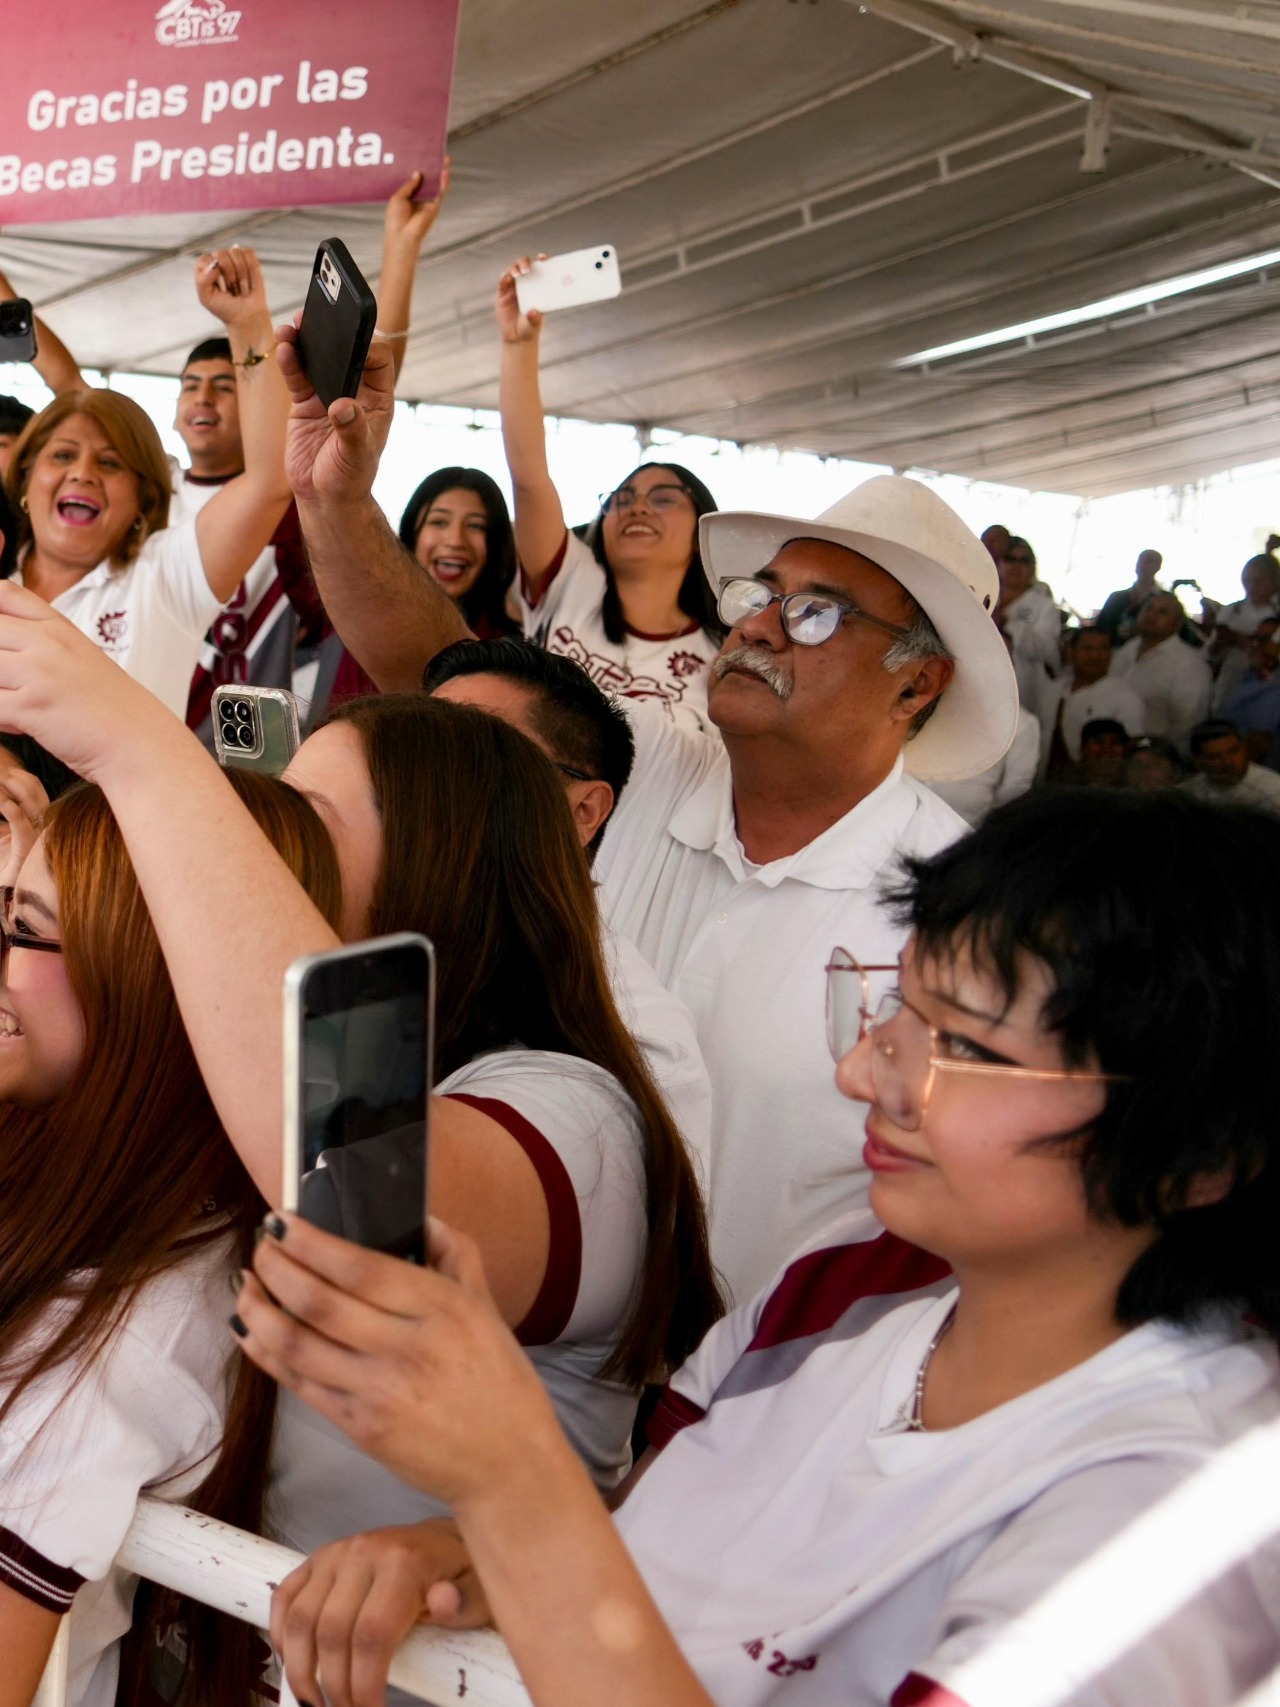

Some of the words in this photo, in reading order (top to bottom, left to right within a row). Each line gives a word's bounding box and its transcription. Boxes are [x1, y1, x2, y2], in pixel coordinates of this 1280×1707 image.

[216, 9, 241, 36] 97
[27, 79, 189, 131] Gracias
[201, 74, 283, 124] por
[296, 60, 368, 104] las
[131, 126, 394, 184] Presidenta.
